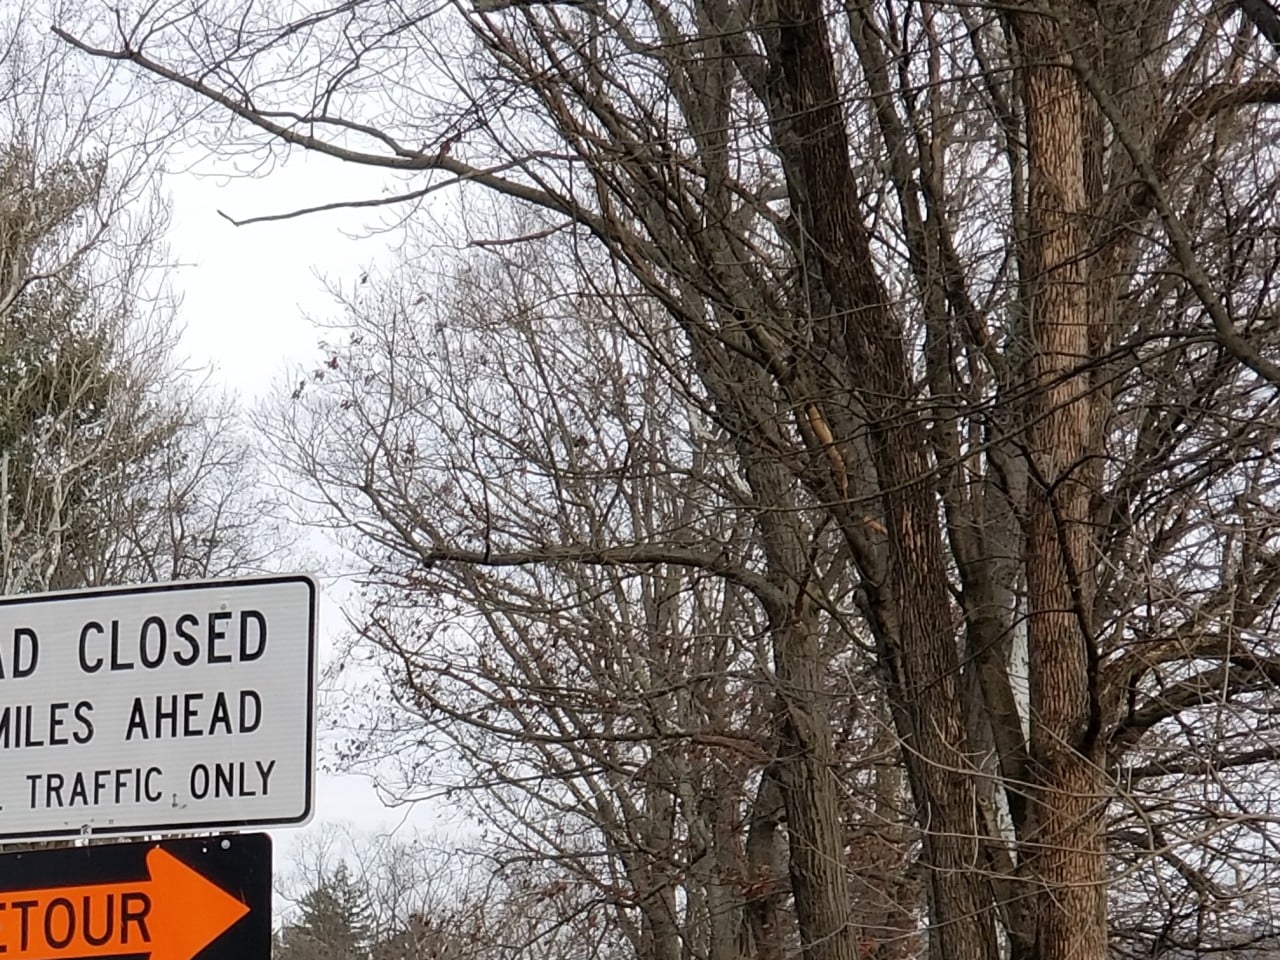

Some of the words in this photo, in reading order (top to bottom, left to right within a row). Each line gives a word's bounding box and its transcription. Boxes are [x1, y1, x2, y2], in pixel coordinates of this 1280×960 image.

[78, 609, 268, 675] CLOSED
[125, 689, 263, 741] AHEAD
[27, 766, 163, 809] TRAFFIC
[190, 759, 277, 801] ONLY
